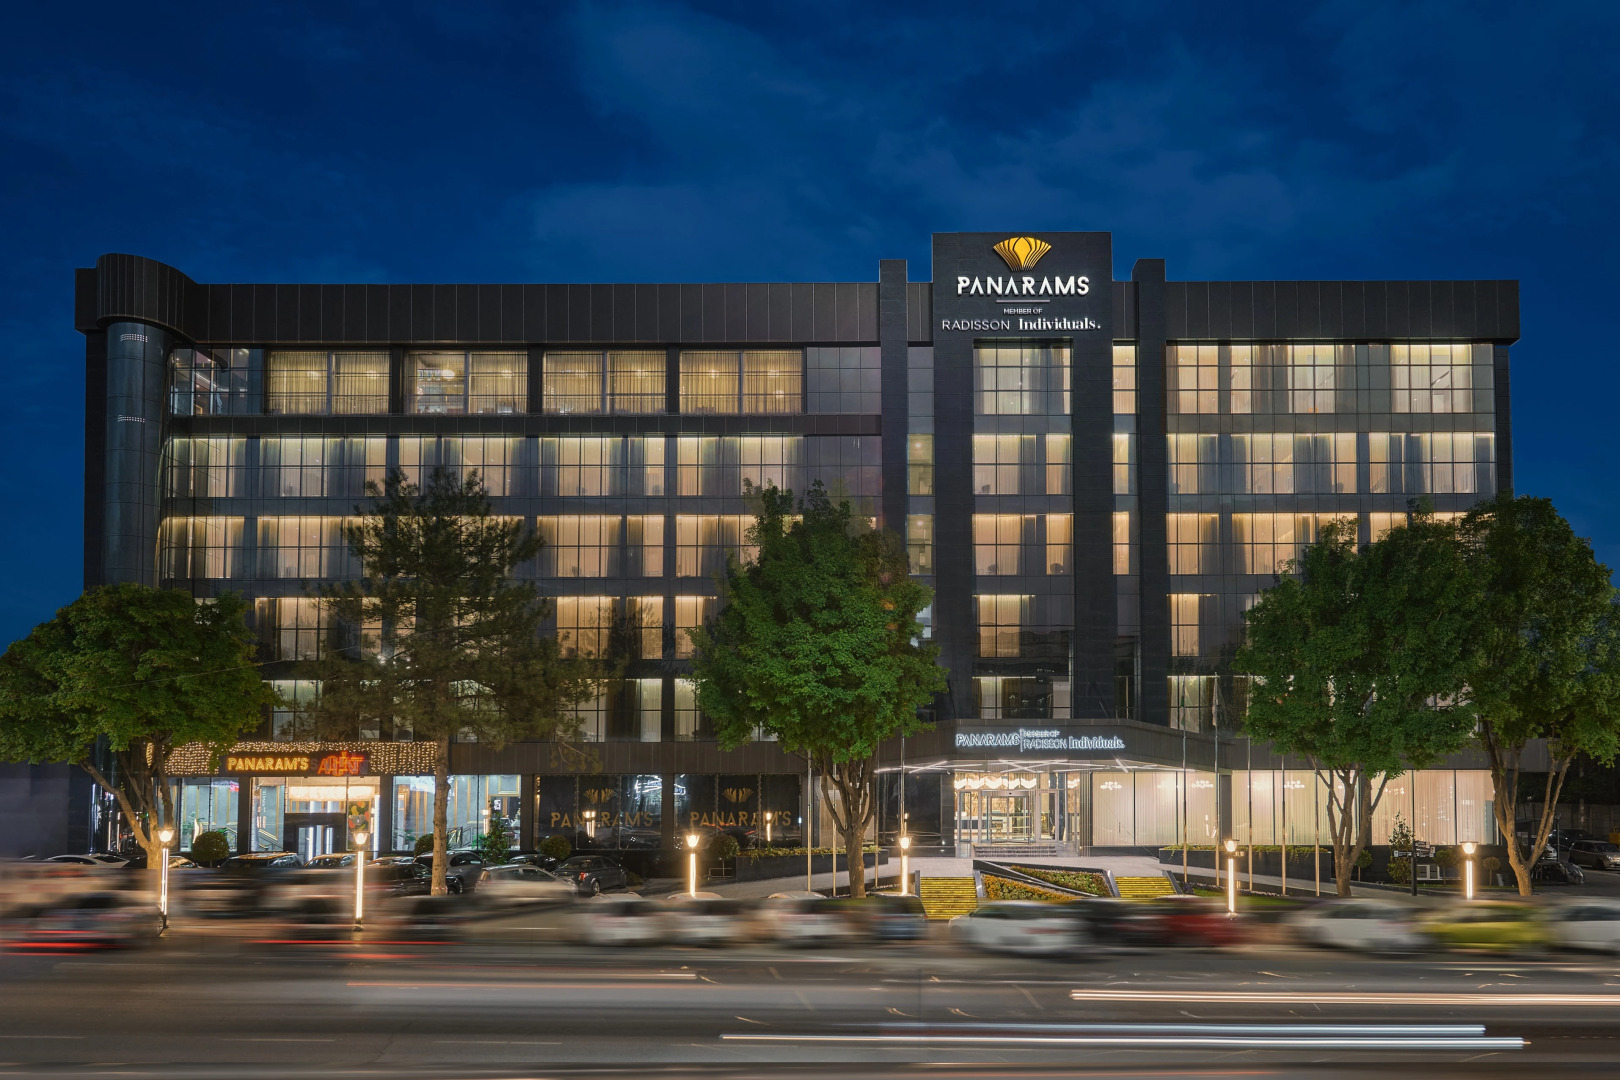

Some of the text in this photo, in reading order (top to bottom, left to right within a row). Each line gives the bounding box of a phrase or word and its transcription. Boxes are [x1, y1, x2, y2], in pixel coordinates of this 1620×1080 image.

[957, 276, 1090, 296] PANARAMS
[942, 319, 1010, 331] RADISSON
[955, 733, 1020, 747] PANARAMS
[1023, 738, 1068, 749] RADISSON
[227, 757, 310, 771] PANARAM'S
[550, 811, 654, 828] PANRAM'S
[689, 811, 793, 827] PANARAM'S
